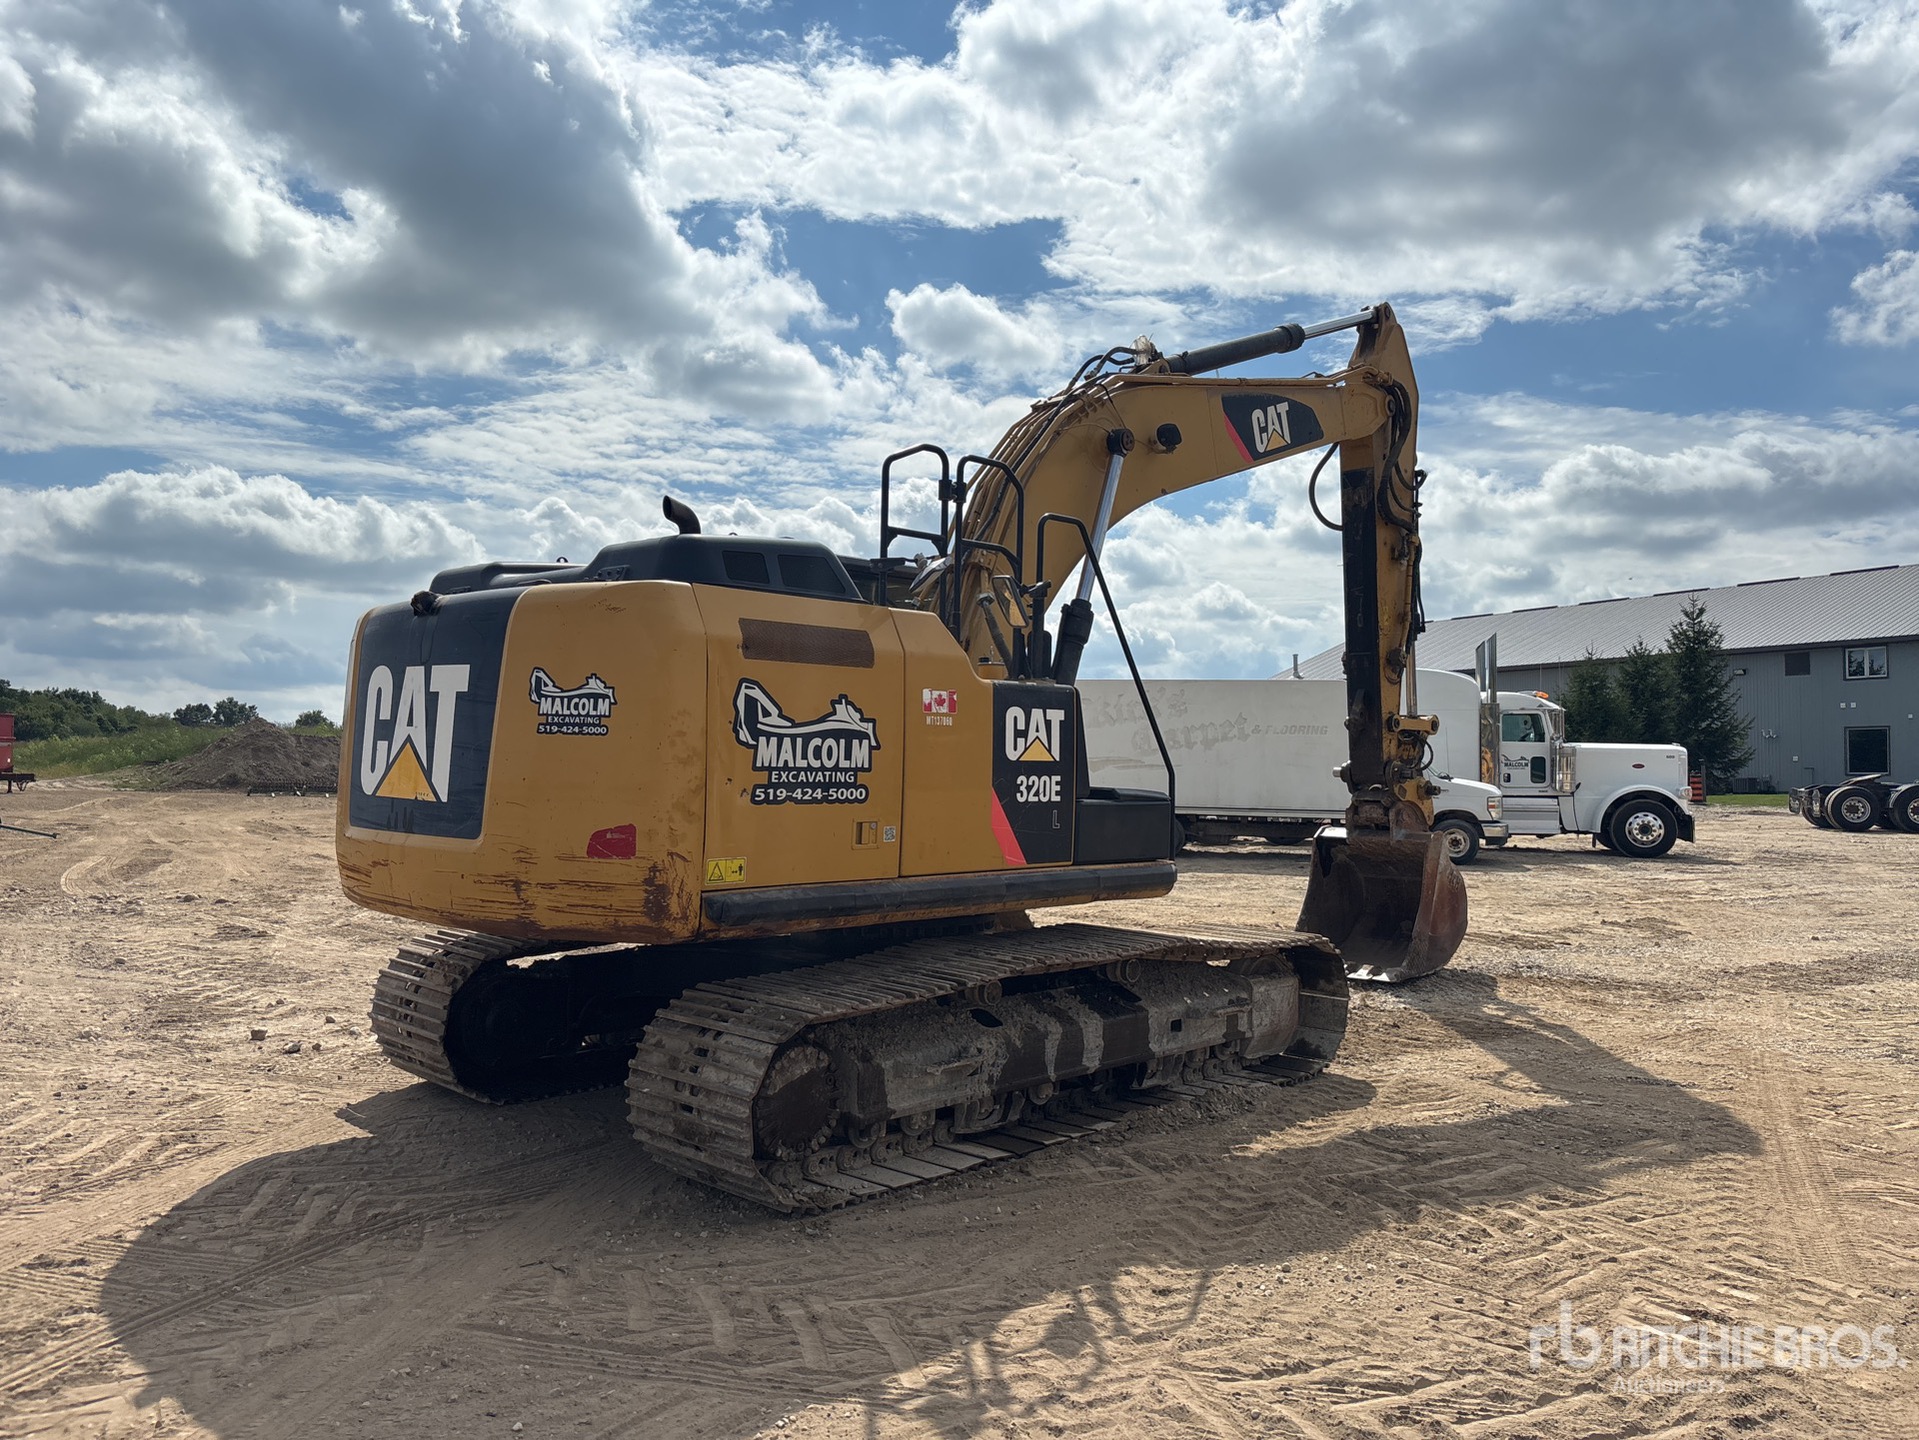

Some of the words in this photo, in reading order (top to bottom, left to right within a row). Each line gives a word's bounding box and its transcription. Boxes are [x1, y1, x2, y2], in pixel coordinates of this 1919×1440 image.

[1252, 401, 1291, 453] CAT
[540, 697, 610, 716] MALCOLM
[538, 725, 607, 734] 519-424-5000
[548, 716, 600, 724] EXCAVATING
[360, 664, 471, 803] CAT
[1005, 706, 1065, 761] CAT
[756, 736, 870, 768] MALCOLM
[771, 771, 855, 783] EXCAVATING
[754, 788, 866, 801] 519-424-5000
[1016, 775, 1061, 803] 320E
[1052, 809, 1060, 829] L
